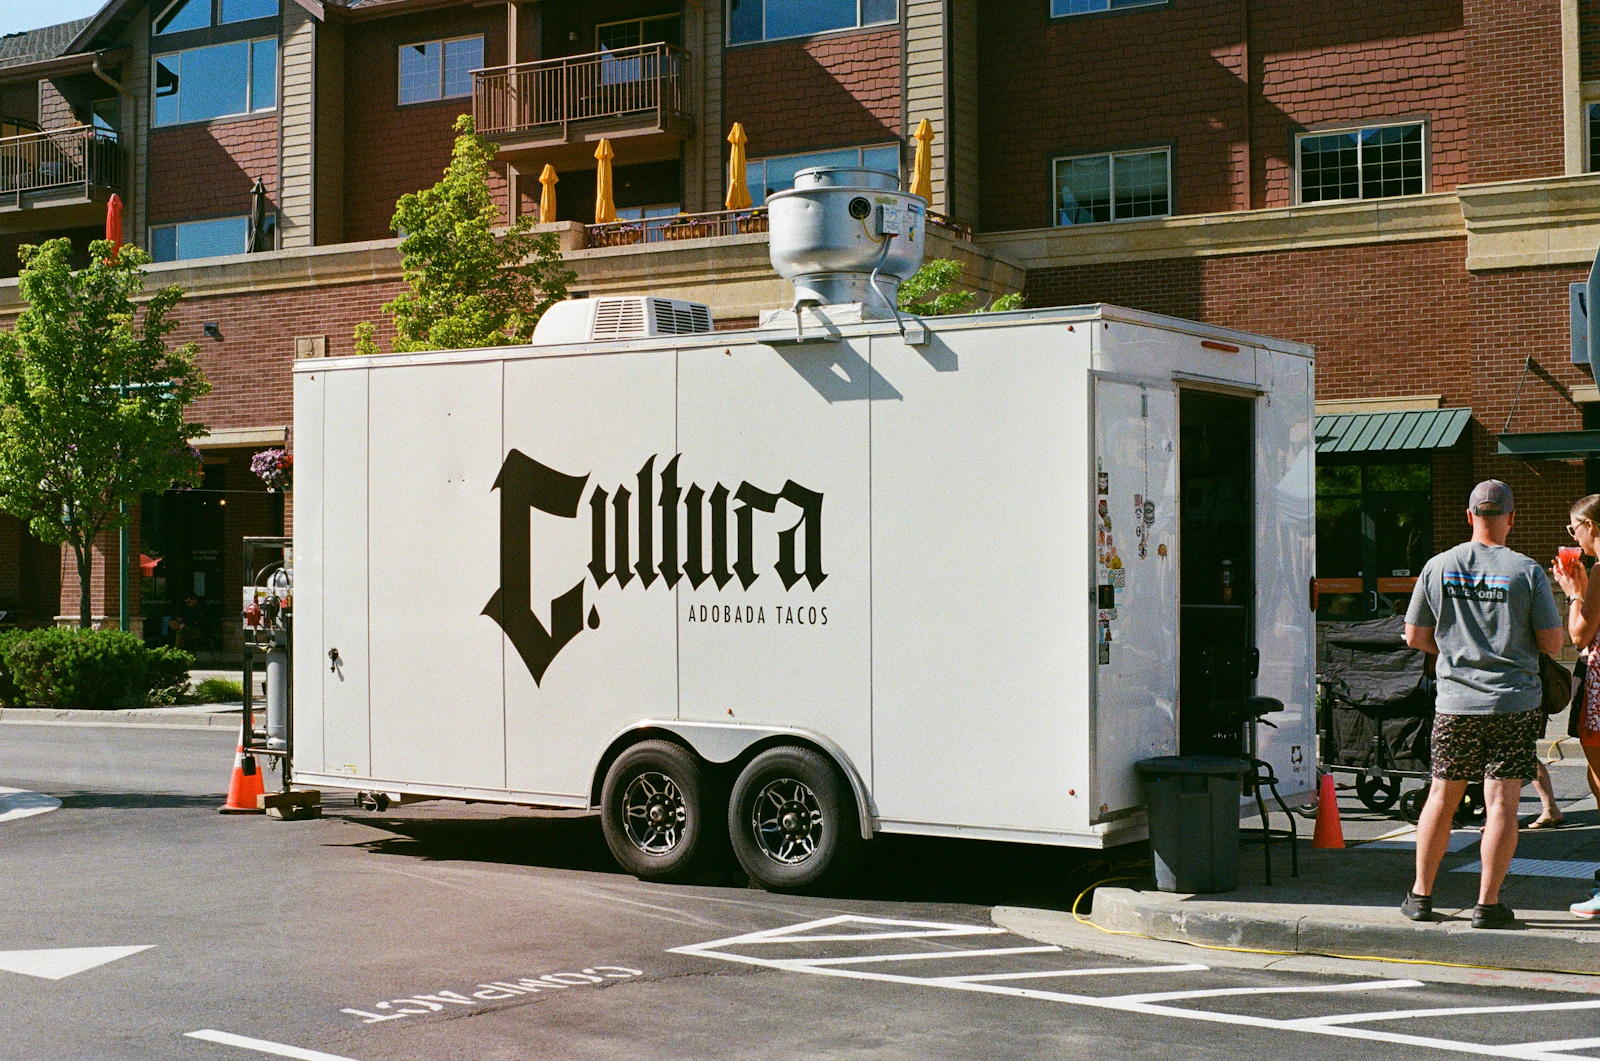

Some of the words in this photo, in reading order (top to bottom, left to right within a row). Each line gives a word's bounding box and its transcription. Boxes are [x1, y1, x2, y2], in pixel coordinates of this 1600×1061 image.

[479, 448, 828, 688] Cultura
[1446, 586, 1504, 600] paaonia
[688, 604, 765, 624] ADOBADA
[776, 606, 829, 625] TACOS
[339, 966, 643, 1024] COMPACT
